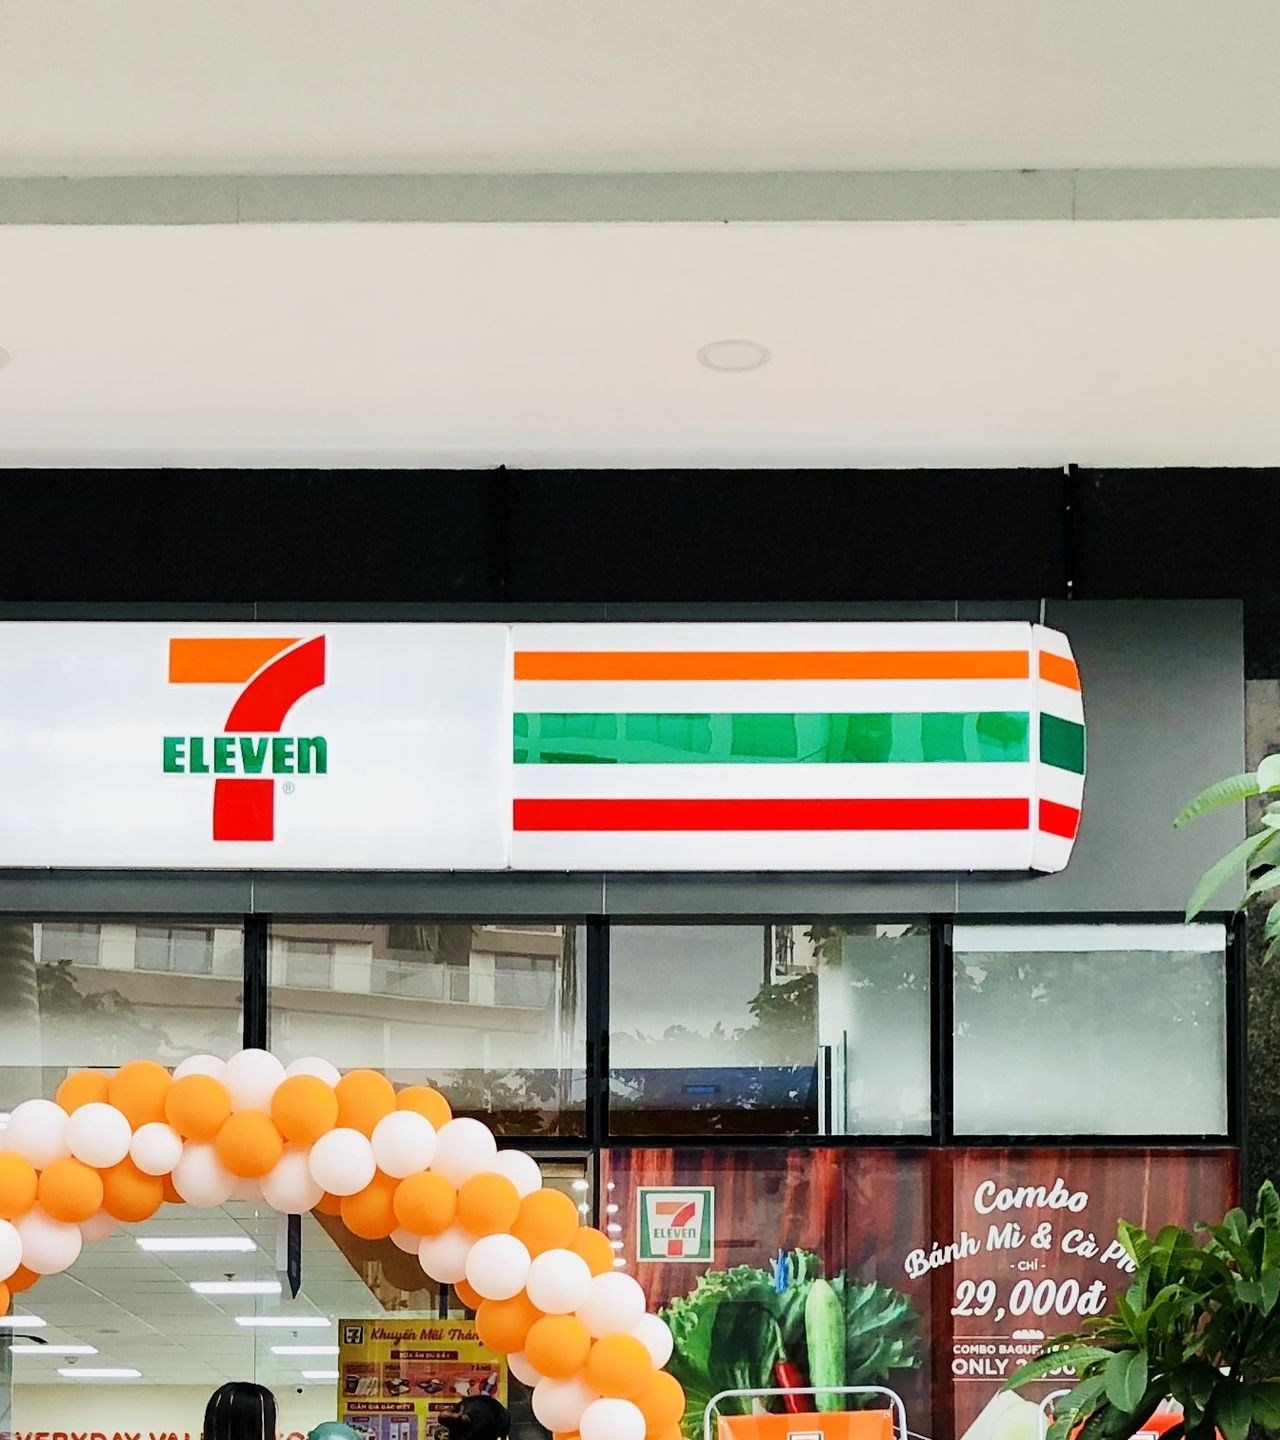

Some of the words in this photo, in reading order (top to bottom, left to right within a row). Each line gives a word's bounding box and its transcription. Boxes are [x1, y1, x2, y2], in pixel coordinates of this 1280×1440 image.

[974, 1177, 1088, 1215] Combo
[905, 1232, 981, 1280] Bánh
[986, 1222, 1025, 1252] Mì
[1030, 1222, 1053, 1250] &
[1061, 1229, 1099, 1260] Cà
[951, 1278, 1108, 1323] 29,000đ
[951, 1358, 1009, 1376] ONLY
[952, 1344, 996, 1355] COMBO
